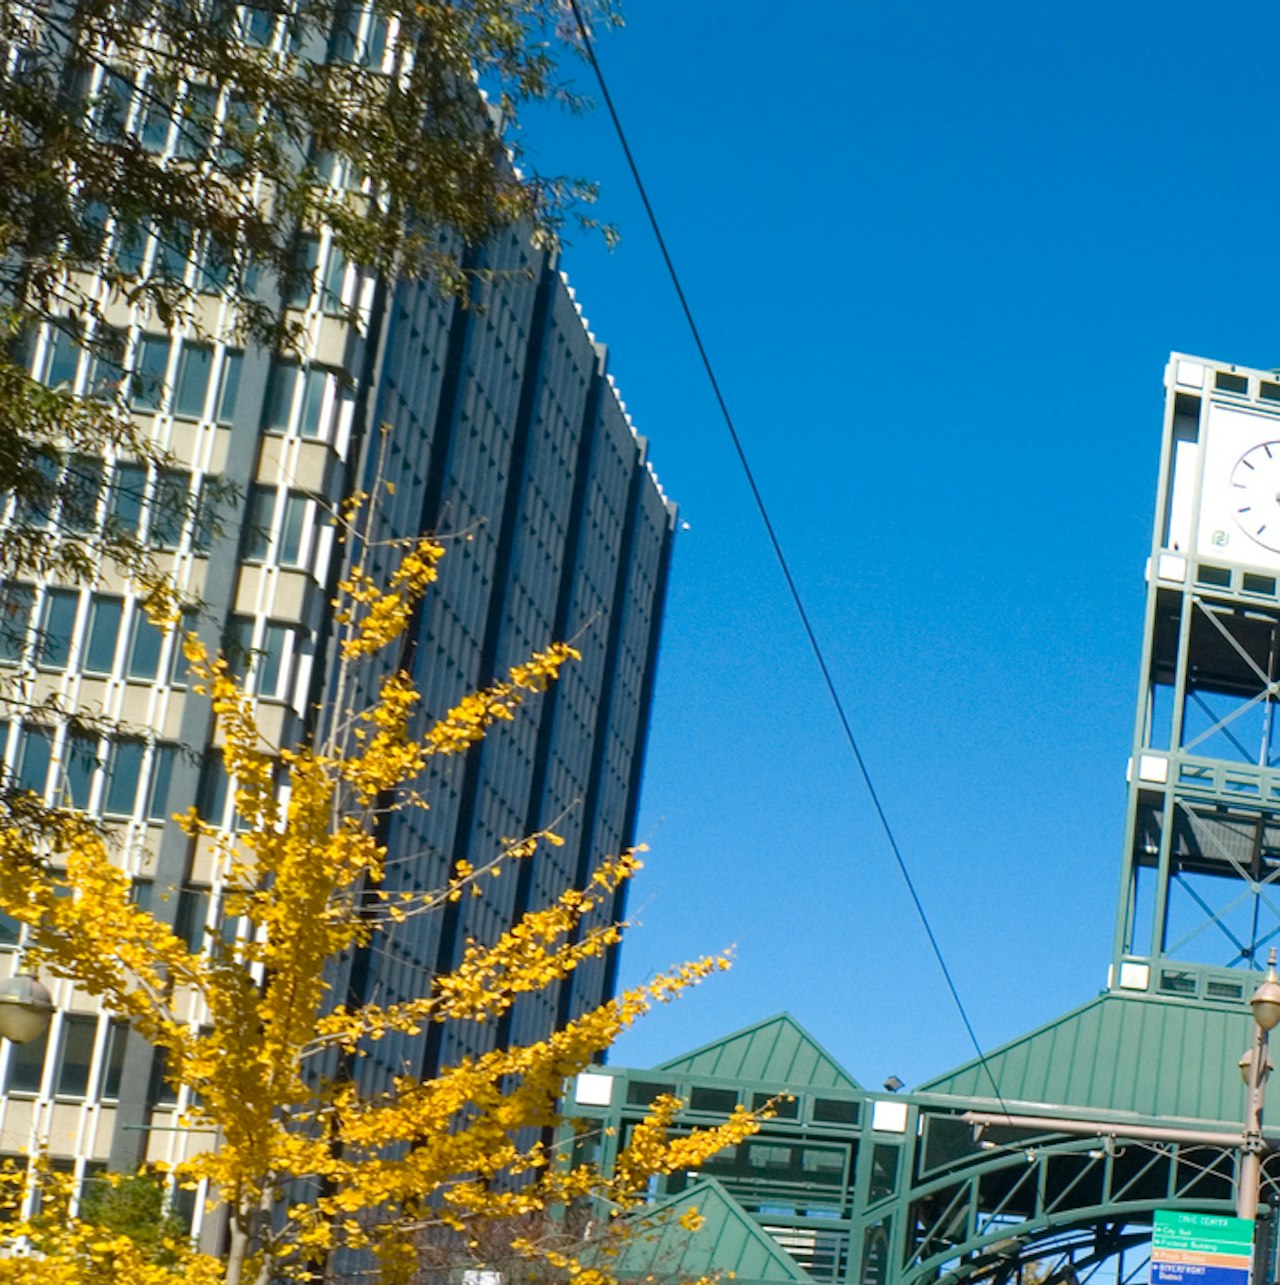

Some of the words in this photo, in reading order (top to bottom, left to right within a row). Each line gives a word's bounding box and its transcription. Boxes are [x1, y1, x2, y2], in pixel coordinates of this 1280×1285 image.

[1178, 1215, 1197, 1225] CIVIC
[1200, 1217, 1229, 1227] CENTER
[1163, 1226, 1175, 1236] City
[1190, 1240, 1218, 1252] Building
[1159, 1263, 1206, 1275] RIVERFRONT
